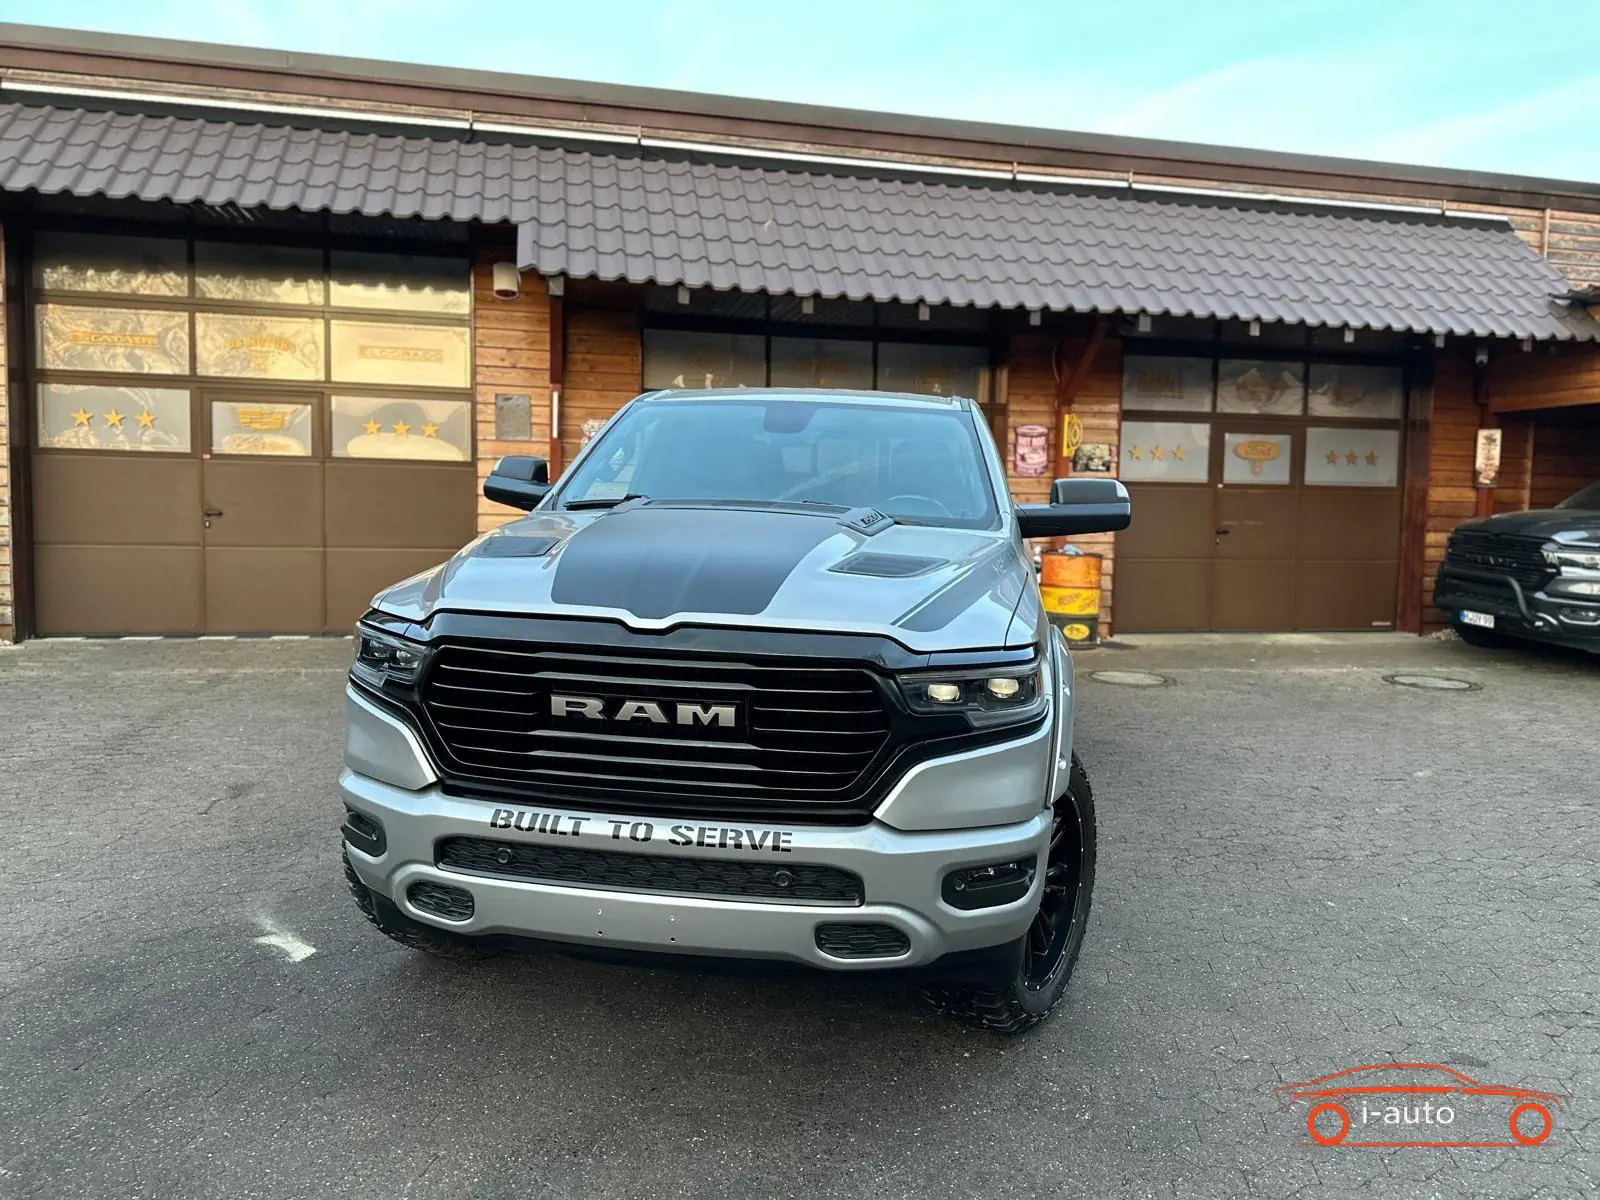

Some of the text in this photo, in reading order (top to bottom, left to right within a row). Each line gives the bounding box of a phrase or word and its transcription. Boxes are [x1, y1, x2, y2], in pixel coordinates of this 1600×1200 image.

[551, 694, 736, 727] RAM
[490, 808, 792, 852] BUILT TO SERVE
